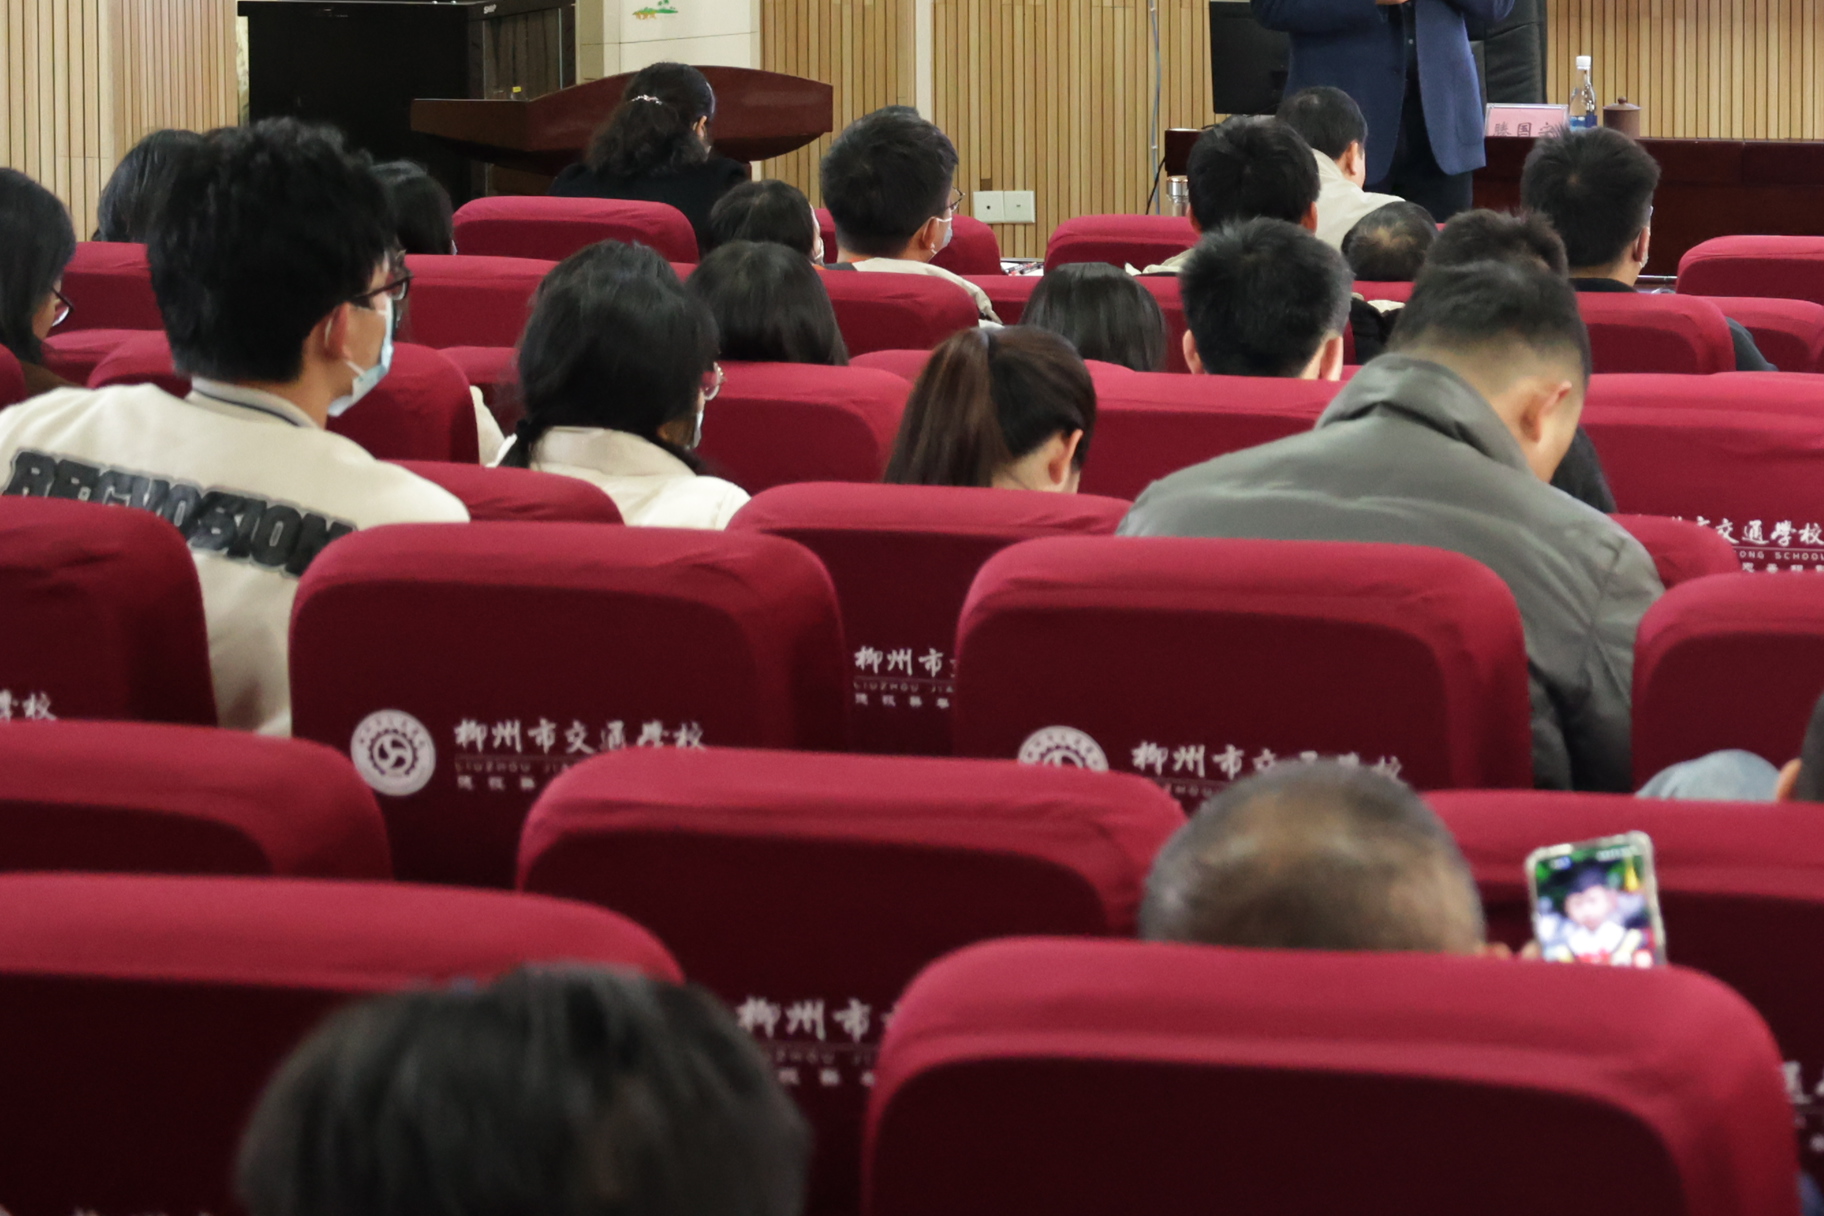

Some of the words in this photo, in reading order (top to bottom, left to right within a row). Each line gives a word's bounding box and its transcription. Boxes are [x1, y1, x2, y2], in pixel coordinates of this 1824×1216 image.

[854, 646, 957, 678] 柳州市
[736, 997, 892, 1043] 柳州市
